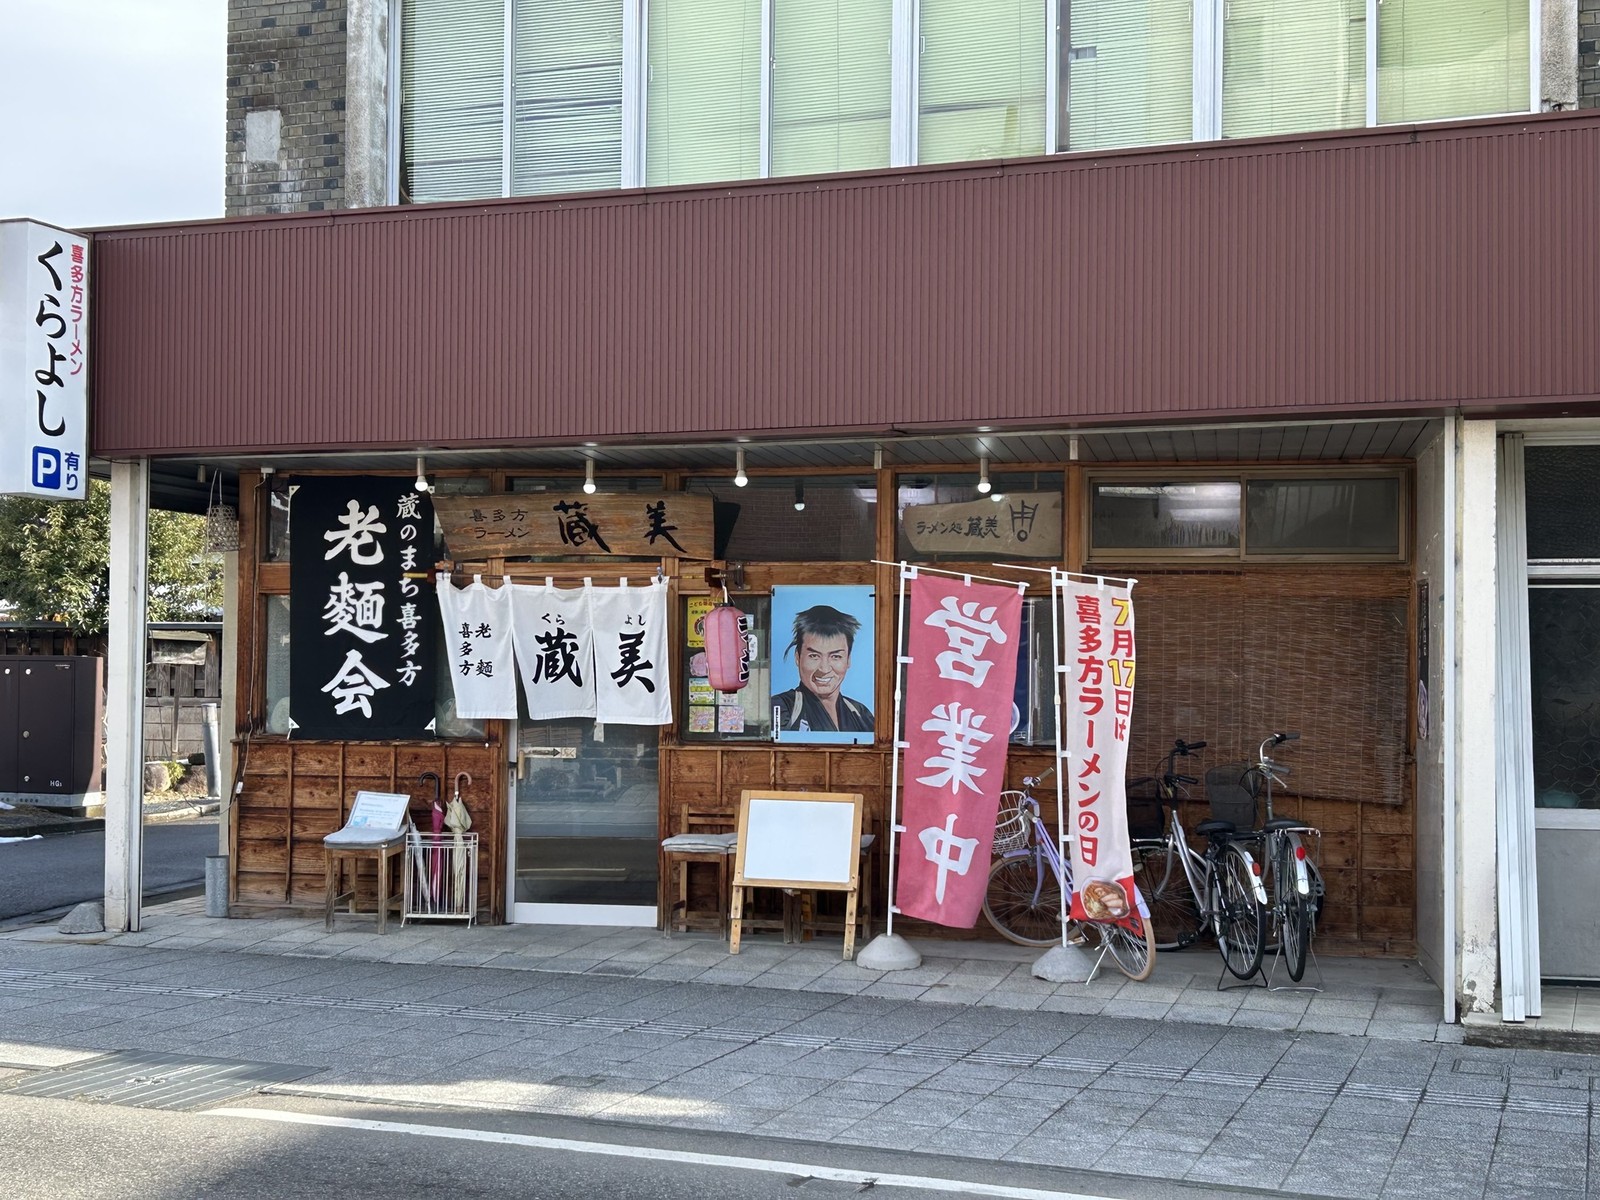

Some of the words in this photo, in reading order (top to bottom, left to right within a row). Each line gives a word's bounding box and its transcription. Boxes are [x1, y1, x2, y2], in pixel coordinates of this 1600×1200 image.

[70, 244, 84, 376] 喜多方ラーメン
[35, 241, 67, 437] くらよし
[37, 452, 57, 484] P
[64, 451, 81, 491] 有り
[468, 508, 529, 522] 喜多方
[473, 526, 530, 539] ラーメン
[396, 492, 423, 687] 蔵のまち喜多方
[541, 613, 566, 625] くら
[624, 614, 647, 626] よし
[458, 622, 474, 676] 喜多方
[1106, 597, 1137, 742] 7月17日は
[916, 596, 1007, 905] 営業中
[1075, 595, 1105, 868] 喜多方ラーメンの日
